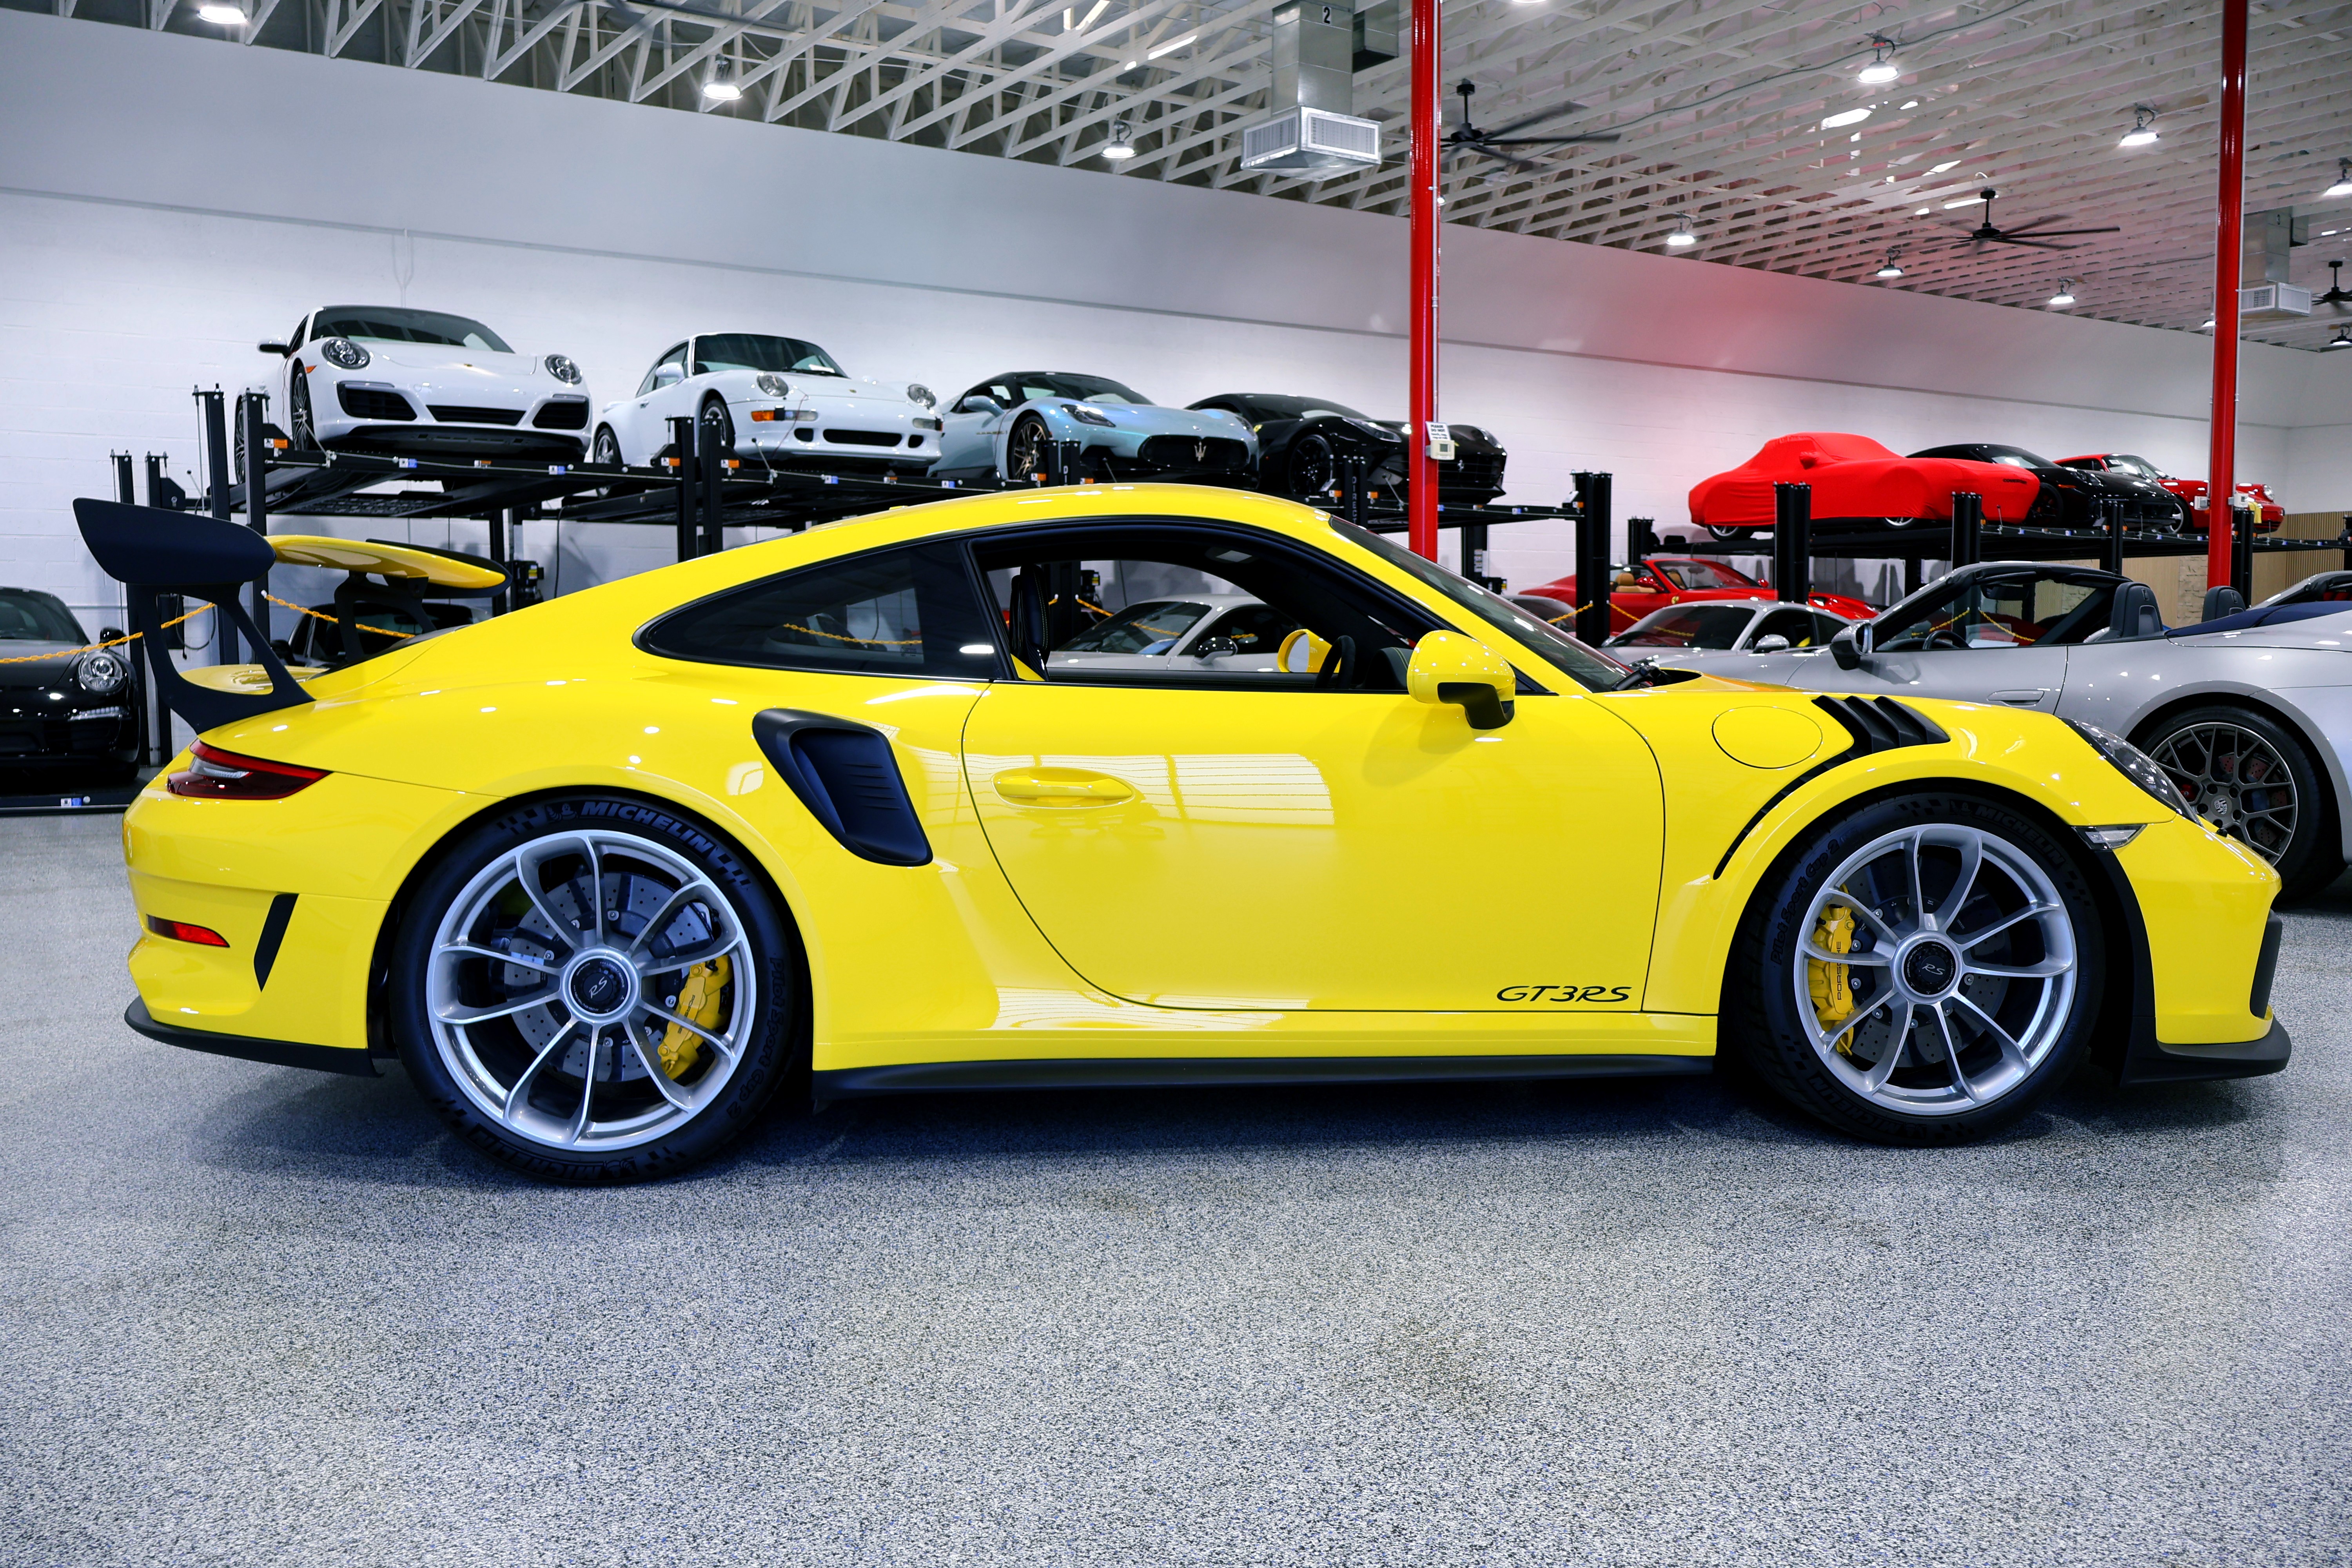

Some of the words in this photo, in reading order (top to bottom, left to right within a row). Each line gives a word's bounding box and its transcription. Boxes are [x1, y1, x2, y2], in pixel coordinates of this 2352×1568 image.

[1323, 7, 1331, 24] 2
[581, 801, 718, 858] MICHELIN
[1975, 805, 2065, 865] MICHELIN
[1771, 922, 1788, 965] Pilot
[1781, 877, 1808, 924] Sport
[1806, 852, 1828, 878] Cup
[1828, 839, 1840, 854] 2
[588, 976, 607, 999] RS
[770, 957, 785, 1007] Pilot
[1922, 963, 1945, 975] RS
[759, 1009, 784, 1067] Sport
[726, 1101, 742, 1119] 2
[740, 1069, 764, 1102] Cup
[1808, 1076, 1902, 1134] MICHELIN
[469, 1129, 602, 1180] MICHELIN
